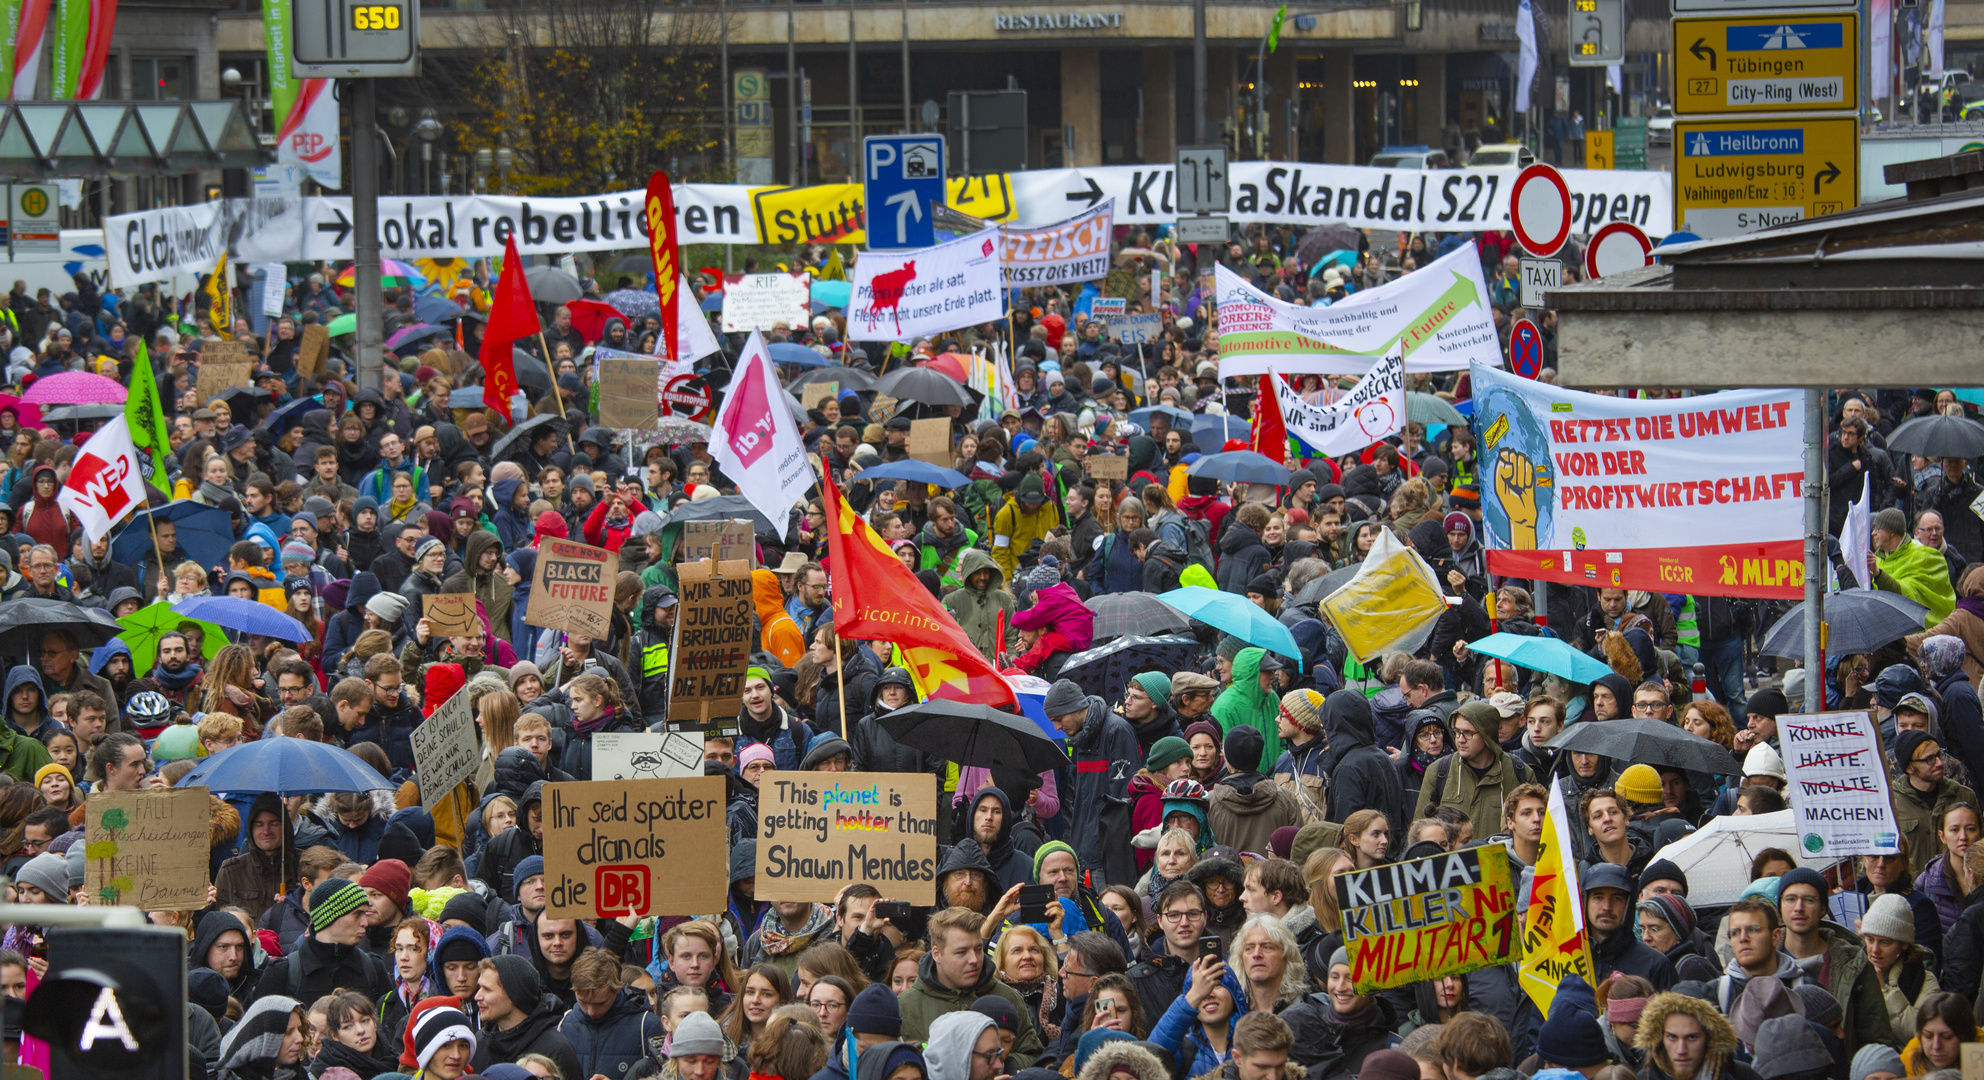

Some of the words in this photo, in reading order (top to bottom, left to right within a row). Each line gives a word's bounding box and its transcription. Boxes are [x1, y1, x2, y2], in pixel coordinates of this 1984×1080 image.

[269, 8, 281, 21] in
[354, 6, 400, 30] 650
[994, 12, 1125, 31] RESTAURANT
[270, 25, 287, 90] Zeitarbeit
[1581, 43, 1596, 55] 20
[1726, 57, 1804, 76] Tübingen
[741, 75, 757, 95] S
[1695, 81, 1711, 93] 27
[1732, 84, 1793, 103] City-Ring
[1798, 81, 1839, 101] (West)
[742, 104, 756, 120] U
[1719, 134, 1799, 151] Heilbronn
[870, 143, 896, 181] P
[1695, 161, 1805, 180] Ludwigsburg
[29, 194, 41, 211] H
[1128, 167, 1428, 228] KlaSkandal
[1436, 174, 1500, 222] S21
[1684, 184, 1769, 203] Vaihingen/Enz
[1782, 185, 1796, 198] 10
[1737, 211, 1800, 229] S-Nord
[1820, 204, 1836, 217] 27
[377, 202, 458, 250] okal
[472, 197, 741, 248] rebellieen
[756, 276, 778, 289] RIP
[1046, 264, 1069, 280] DIE
[1525, 266, 1556, 287] TAXI
[854, 308, 886, 322] Fleisch
[888, 306, 911, 321] nicht
[912, 302, 942, 319] unsere
[944, 296, 966, 312] Erde
[968, 287, 996, 309] platt.
[1535, 290, 1546, 301] fre
[1093, 306, 1123, 314] BEFORE
[1217, 303, 1277, 317] UTOMOTIVE
[1328, 310, 1379, 326] nachhaltig
[1379, 304, 1399, 317] und
[1410, 300, 1457, 342] Future
[1121, 328, 1146, 343] EIS
[1355, 324, 1371, 334] der
[1436, 320, 1490, 342] Kostenloser
[1438, 332, 1494, 354] Nahverkehr
[603, 360, 656, 376] E-Autos
[664, 391, 683, 404] KOHLE
[683, 393, 710, 407] STOPPEN!
[1309, 416, 1336, 432] sind
[1549, 416, 1632, 444] RETTET
[1634, 414, 1676, 441] DIE
[1678, 401, 1791, 438] UMWELT
[1555, 451, 1601, 477] VOR
[1601, 449, 1648, 476] DER
[1560, 471, 1805, 511] PROFITWIRTSCHAFT
[686, 521, 707, 534] LET
[709, 521, 724, 532] IT
[558, 545, 578, 555] ACT
[580, 547, 603, 559] NOW
[546, 562, 601, 584] BLACK
[1659, 564, 1694, 583] ICOR
[1742, 558, 1806, 587] MLPD
[551, 583, 609, 603] FUTURE
[682, 582, 713, 602] WIR
[718, 578, 752, 598] SIND
[682, 626, 750, 648] BRAUCHEN
[687, 647, 740, 671] KOHLE
[673, 676, 696, 697] DIE
[701, 672, 744, 697] WELT
[414, 726, 426, 749] ES
[428, 712, 440, 735] IST
[441, 690, 462, 721] NICHT
[1788, 721, 1864, 743] KÖNNTE.
[416, 736, 439, 765] DEINE
[1800, 750, 1866, 767] HÄTTE.
[421, 769, 431, 786] ES
[445, 743, 460, 761] NUR
[423, 774, 443, 801] DEINE
[774, 780, 818, 806] This
[822, 782, 880, 812] planet
[889, 788, 903, 807] is
[1801, 776, 1877, 797] WOLLTE.
[552, 789, 581, 829] Ihr
[588, 791, 628, 823] seid
[633, 788, 719, 832] später
[1804, 807, 1885, 822] MACHEN!
[764, 809, 829, 843] getting
[835, 808, 894, 833] hotter
[898, 811, 937, 837] than
[114, 853, 158, 877] KEINE
[765, 843, 843, 881] Shawn
[848, 843, 935, 882] Mendes
[550, 873, 588, 908] die
[603, 872, 643, 908] DB
[1344, 852, 1481, 907] KLIMA-
[1342, 887, 1470, 942] KILLER
[1473, 884, 1514, 917] Nr.
[1491, 909, 1515, 960] 1
[1535, 954, 1589, 982] ANKE
[79, 986, 140, 1052] A
